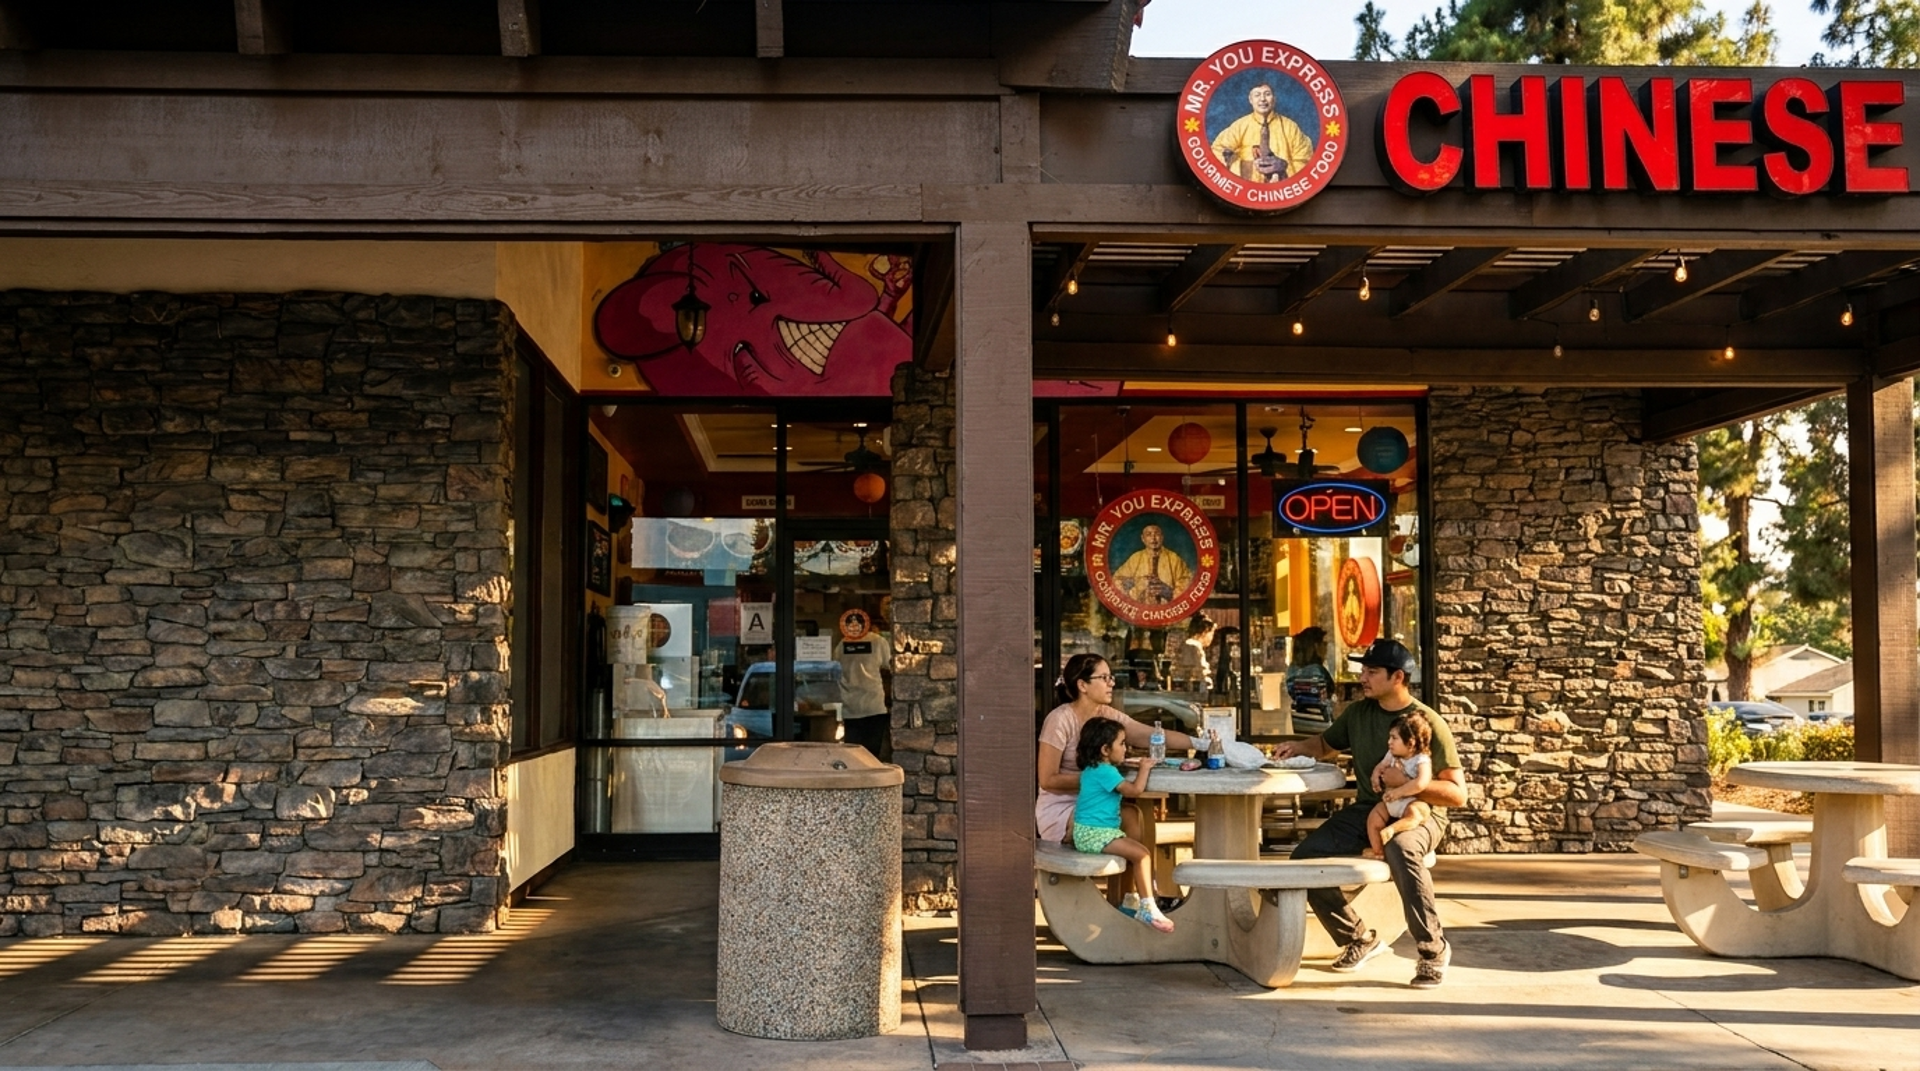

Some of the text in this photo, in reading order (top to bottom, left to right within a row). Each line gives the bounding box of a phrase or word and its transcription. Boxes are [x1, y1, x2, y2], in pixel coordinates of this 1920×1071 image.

[1184, 79, 1215, 114] MR.
[1208, 46, 1254, 77] YOU
[1382, 70, 1910, 195] CHINESE
[1109, 495, 1146, 519] YOU
[1285, 494, 1377, 521] OPEN
[748, 612, 765, 631] A
